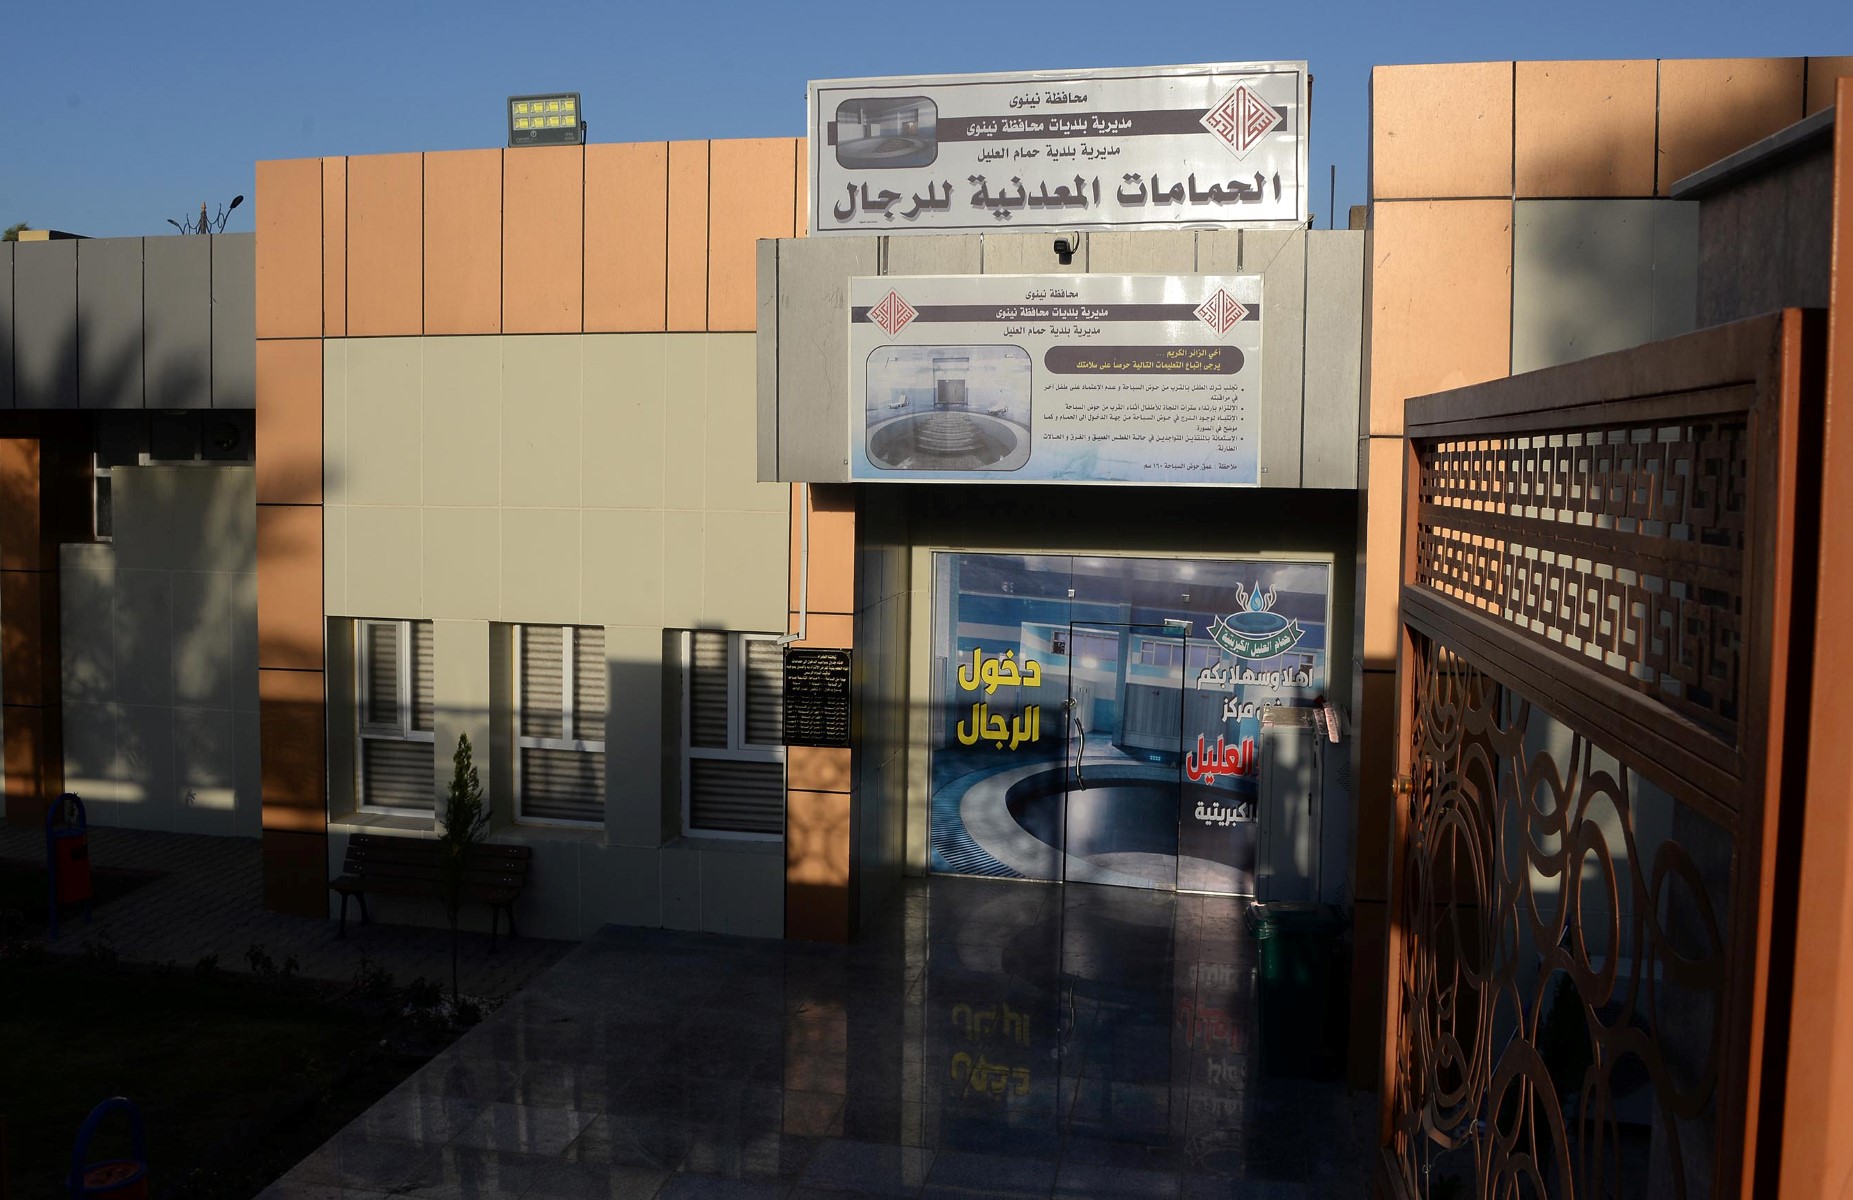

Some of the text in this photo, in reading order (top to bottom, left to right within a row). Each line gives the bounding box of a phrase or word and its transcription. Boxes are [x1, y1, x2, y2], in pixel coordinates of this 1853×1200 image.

[1009, 91, 1088, 109] محافظة نينوى
[966, 115, 1133, 138] مديرية بلديات محافظة نينوى
[977, 142, 1121, 164] مديرية بلدية حمام العليل
[832, 169, 1284, 225] الحمامات المعدنية للرجال
[1025, 288, 1079, 300] محافظة نينوى
[995, 306, 1109, 319] مديرية بلديات محافظة نينوى
[1003, 325, 1101, 338] مديرية بلدية حمام العليل
[1166, 349, 1188, 359] الكريم
[1188, 348, 1207, 359] الزائر
[1208, 348, 1222, 360] أخي
[1076, 361, 1099, 370] سلامتك
[1099, 361, 1112, 371] على
[1132, 360, 1154, 371] التالية
[1155, 360, 1185, 371] التعليمات
[1203, 361, 1222, 372] يرجى
[1122, 384, 1143, 392] السباحة
[1145, 384, 1159, 392] حوض
[1161, 384, 1169, 392] من
[1170, 384, 1189, 392] بالقرب
[1065, 403, 1085, 411] السباحة
[1087, 404, 1099, 412] حوض
[1101, 404, 1109, 412] من
[1123, 414, 1131, 422] من
[1157, 414, 1170, 422] حوض
[1164, 462, 1185, 471] السباحة
[1221, 629, 1291, 657] حمام العليل الكبريتية
[957, 646, 1041, 694] دخول
[1197, 662, 1313, 692] اهلا وسهلا بكم
[1221, 696, 1254, 723] مركز
[956, 701, 1040, 751] الرجال
[1186, 732, 1254, 786] العليل
